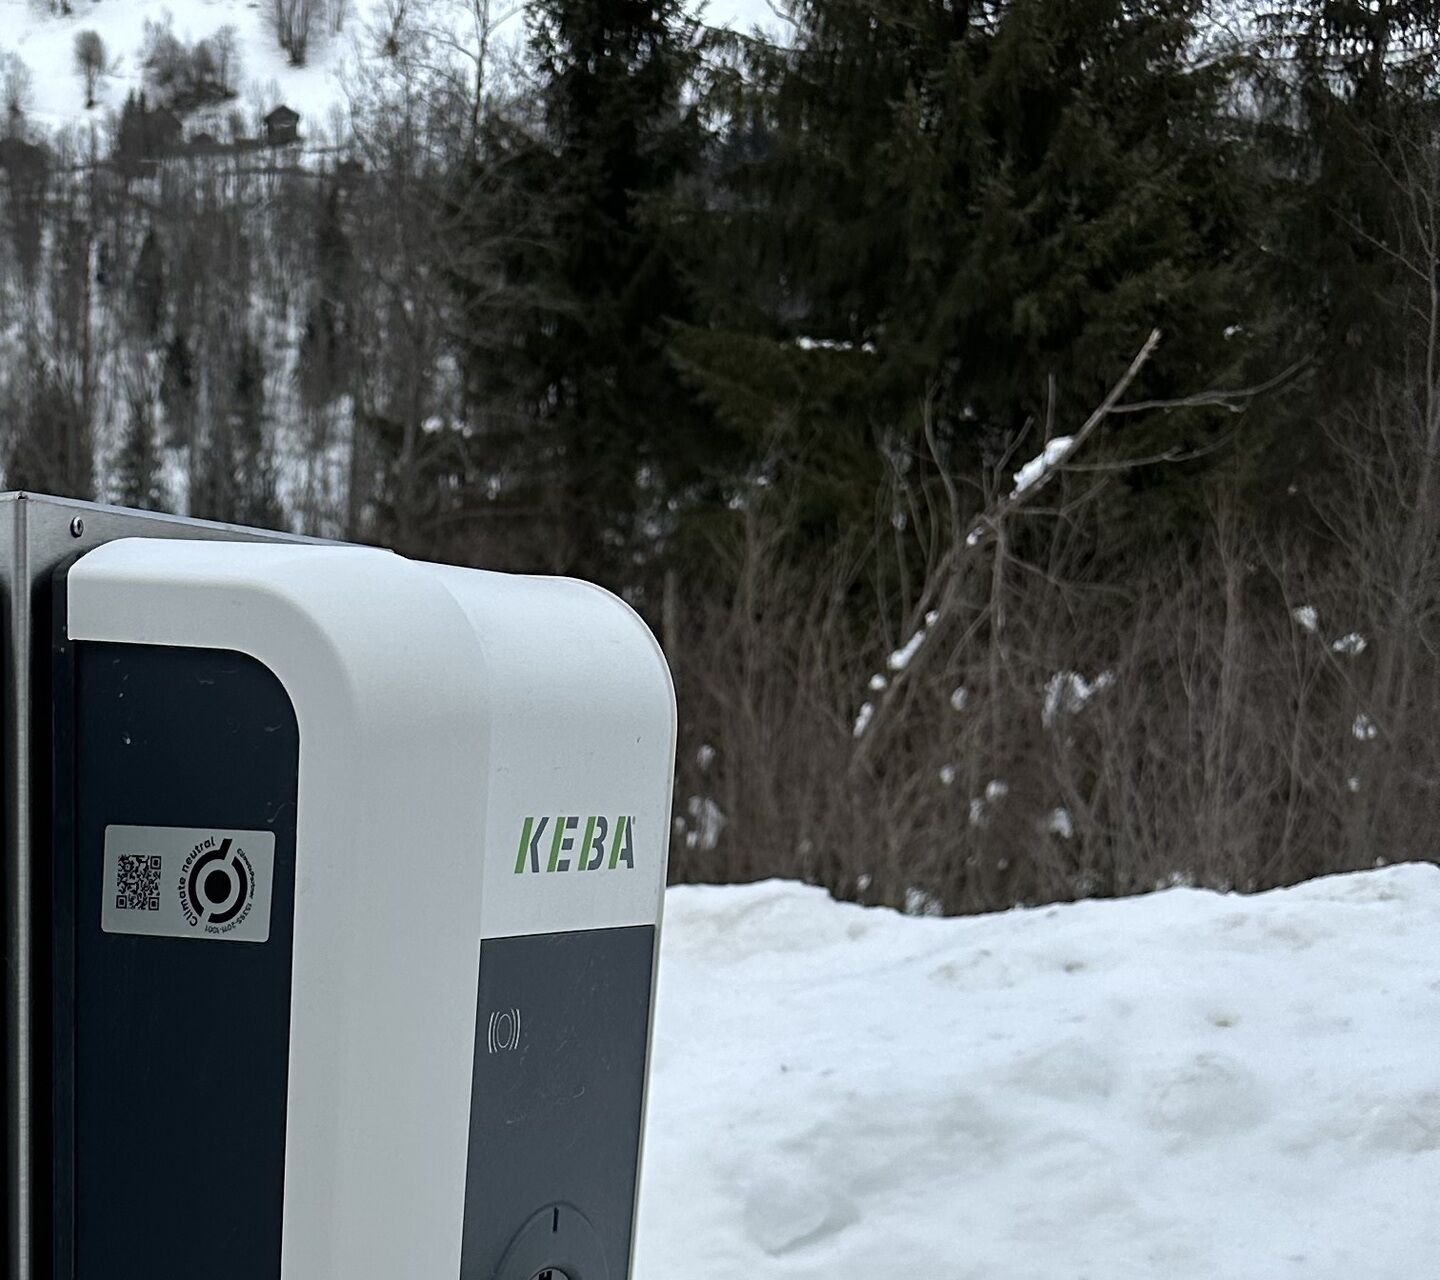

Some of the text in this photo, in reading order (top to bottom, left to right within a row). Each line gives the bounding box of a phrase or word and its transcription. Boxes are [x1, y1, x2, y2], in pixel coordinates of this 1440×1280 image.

[177, 836, 216, 926] Climate neutral
[514, 816, 635, 874] KEBA
